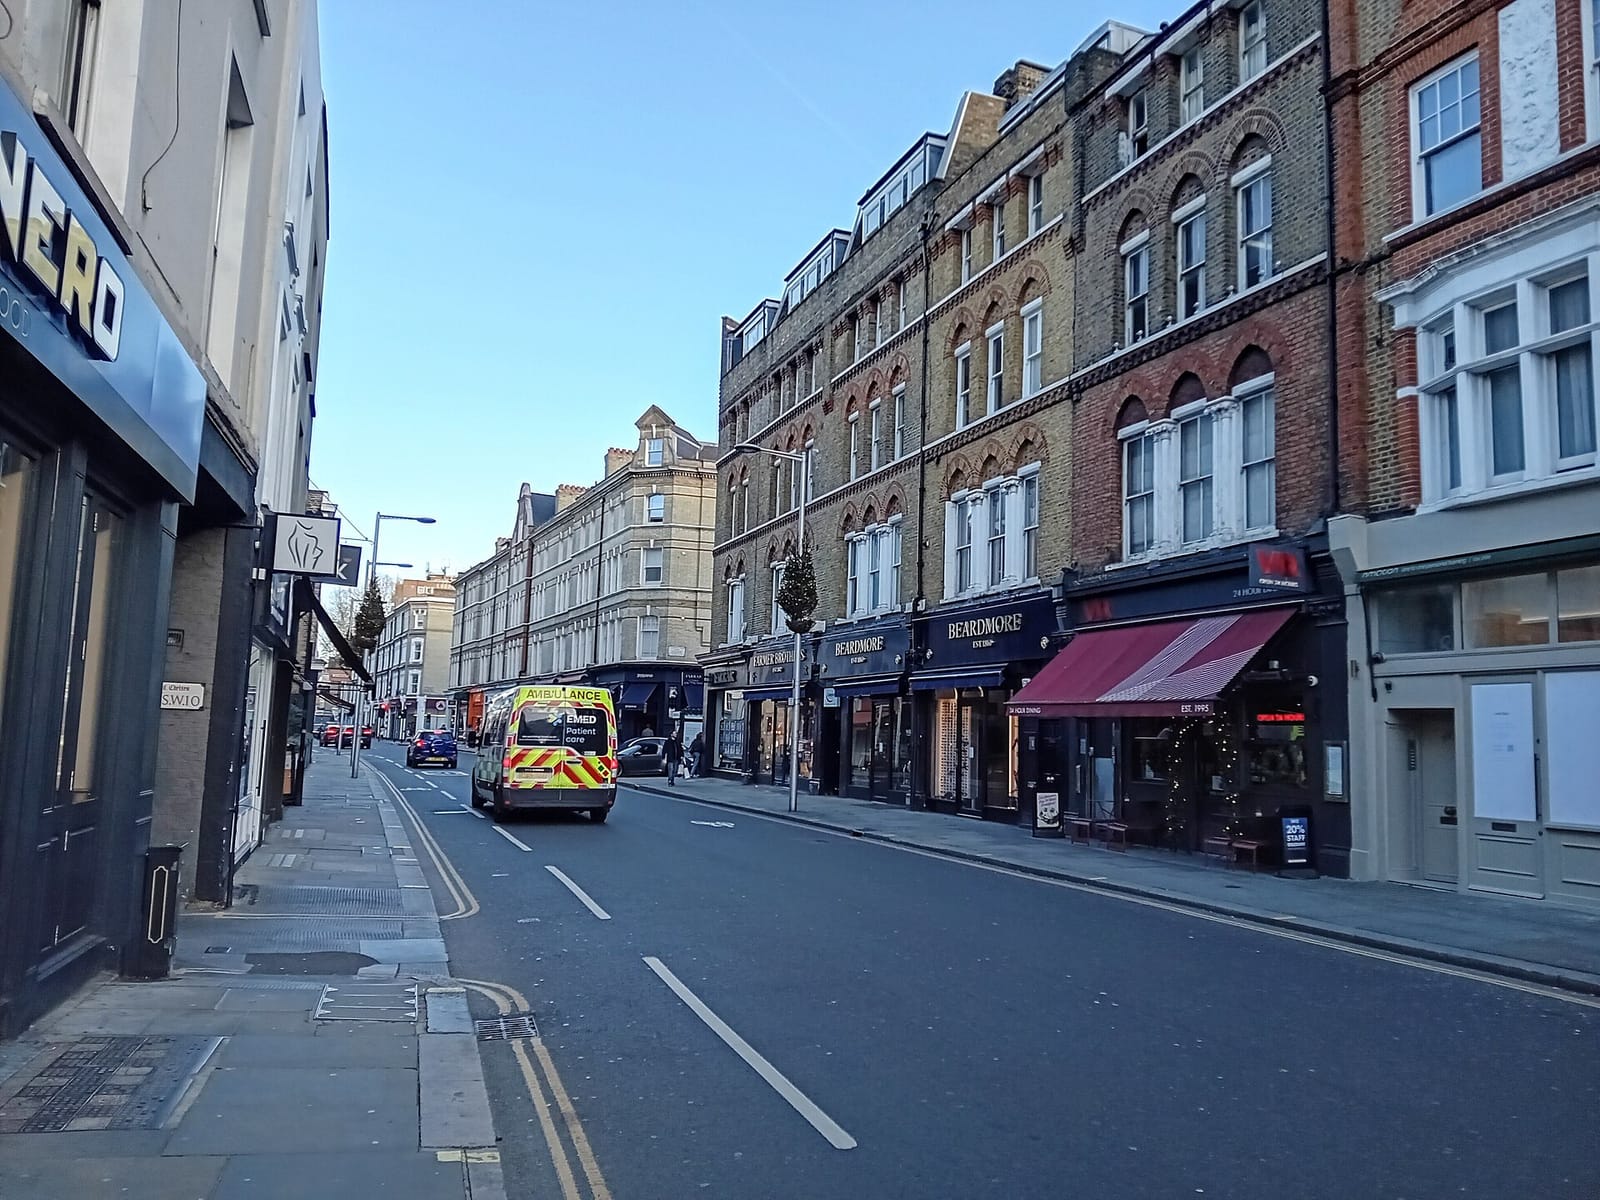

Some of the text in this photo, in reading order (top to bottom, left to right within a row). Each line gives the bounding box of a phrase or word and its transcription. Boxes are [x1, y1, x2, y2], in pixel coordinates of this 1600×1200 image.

[947, 613, 1023, 640] BEARDMORE
[835, 635, 884, 656] BEARDMORE
[527, 689, 601, 701] AMBULANCE
[161, 694, 200, 707] S.W.10
[1194, 704, 1209, 712] 1995
[566, 714, 597, 724] EMED
[566, 727, 596, 736] Patient
[1286, 824, 1306, 834] 20%
[1286, 834, 1306, 842] STAFF
